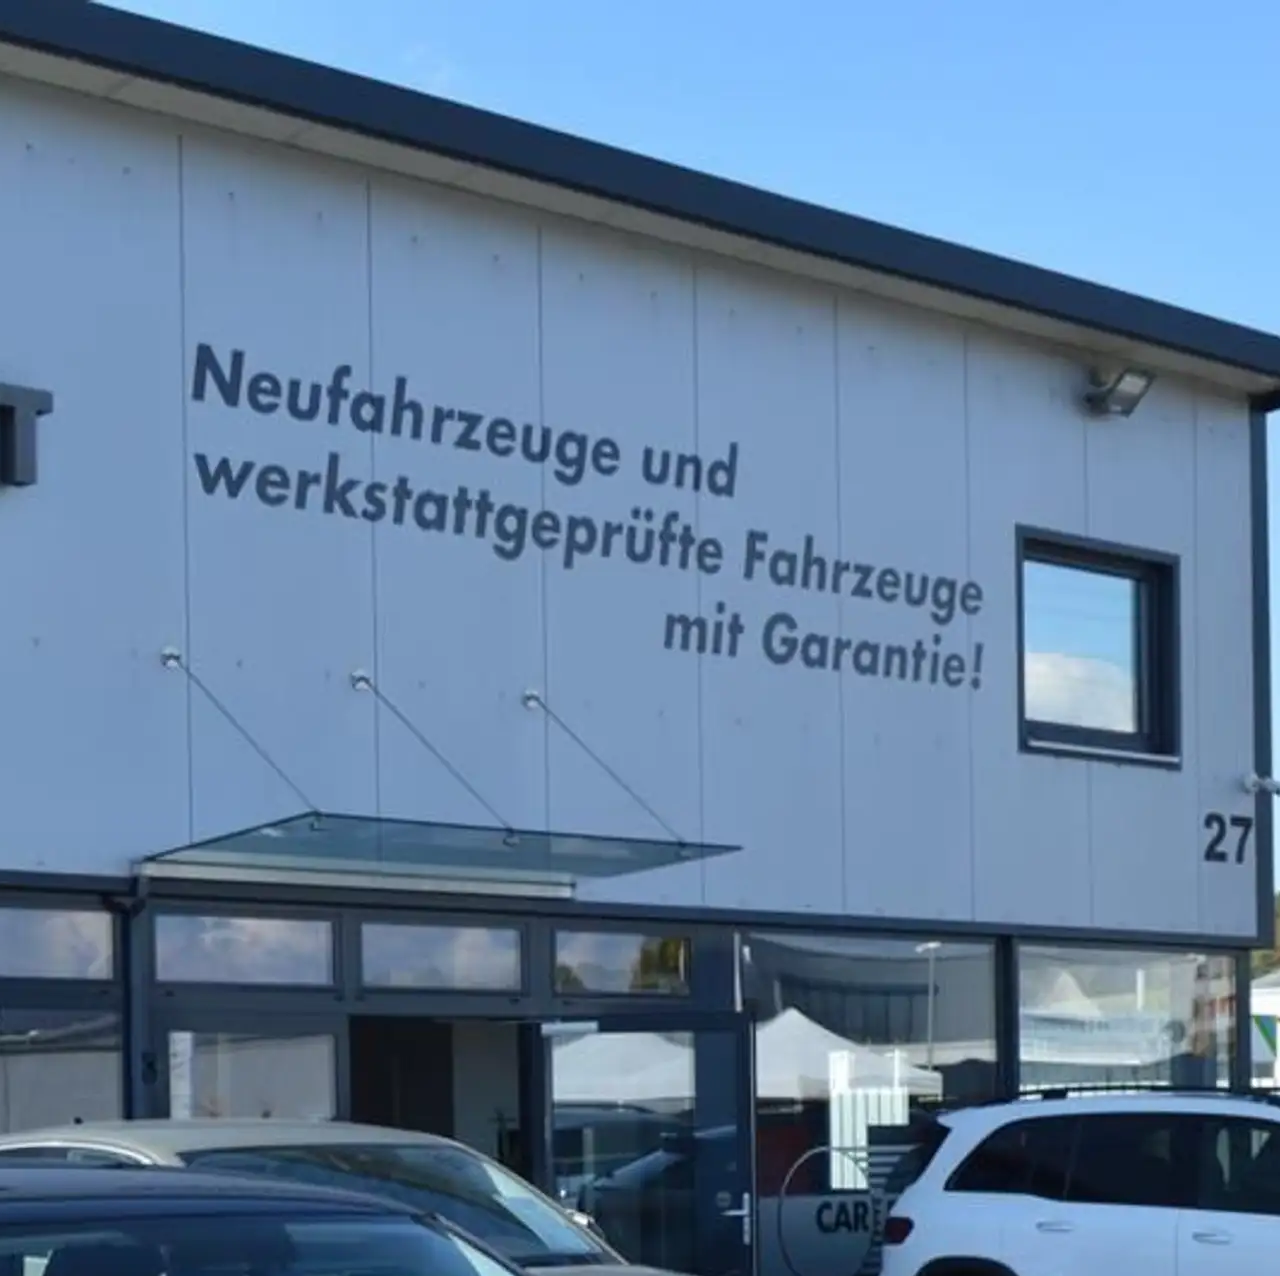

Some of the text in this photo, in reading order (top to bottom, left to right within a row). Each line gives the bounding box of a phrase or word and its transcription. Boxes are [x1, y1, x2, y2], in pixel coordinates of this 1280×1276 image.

[191, 342, 740, 498] Neufahrzeuge und
[193, 451, 984, 626] werkstattgeprüfte Fahrzeuge
[663, 600, 985, 691] mit Garantie!
[1203, 811, 1254, 866] 27
[815, 1200, 870, 1234] CAR
